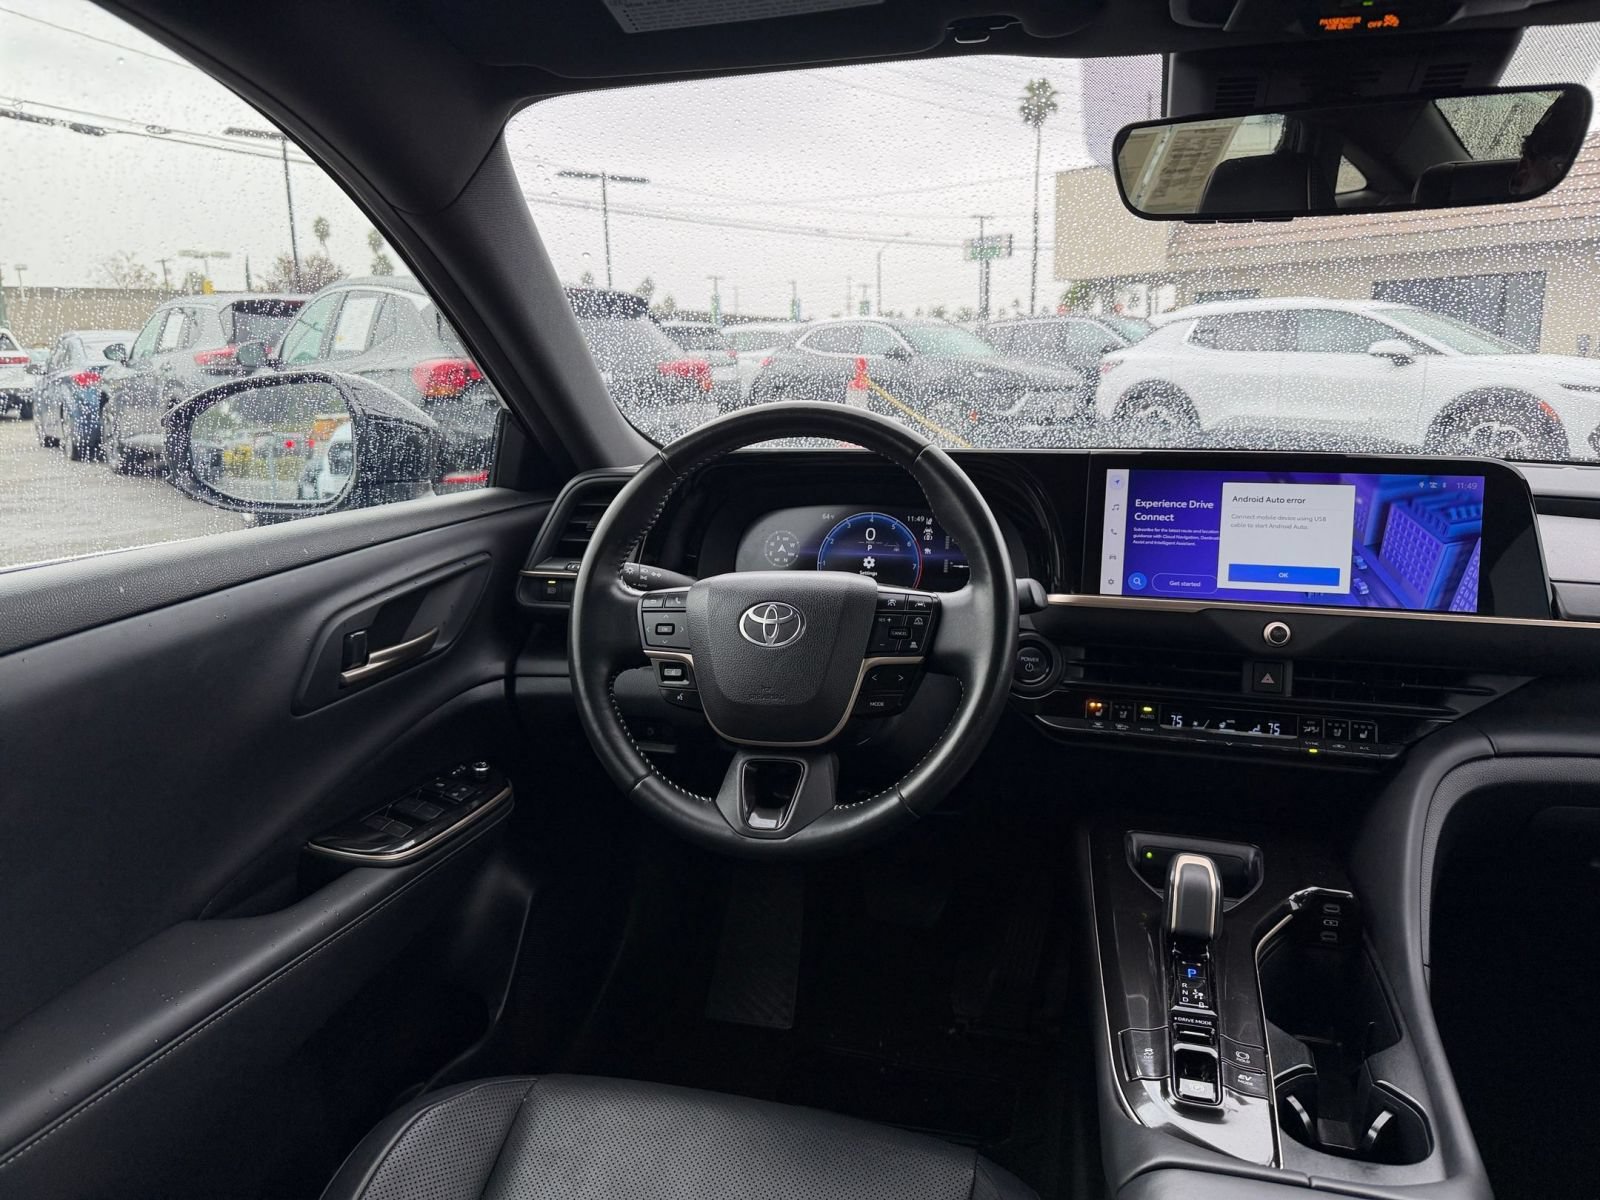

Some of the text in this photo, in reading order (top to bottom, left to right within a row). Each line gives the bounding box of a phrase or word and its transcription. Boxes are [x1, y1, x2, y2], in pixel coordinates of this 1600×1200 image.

[1456, 482, 1478, 490] 11:49
[1135, 499, 1214, 509] Experience Drive
[1232, 495, 1264, 503] Android
[1265, 496, 1285, 504] Auto
[1134, 512, 1175, 521] Connect
[865, 527, 876, 542] 0
[1170, 714, 1183, 728] 75
[1267, 722, 1280, 736] 75
[1187, 968, 1196, 978] P
[1237, 1073, 1252, 1081] EV
